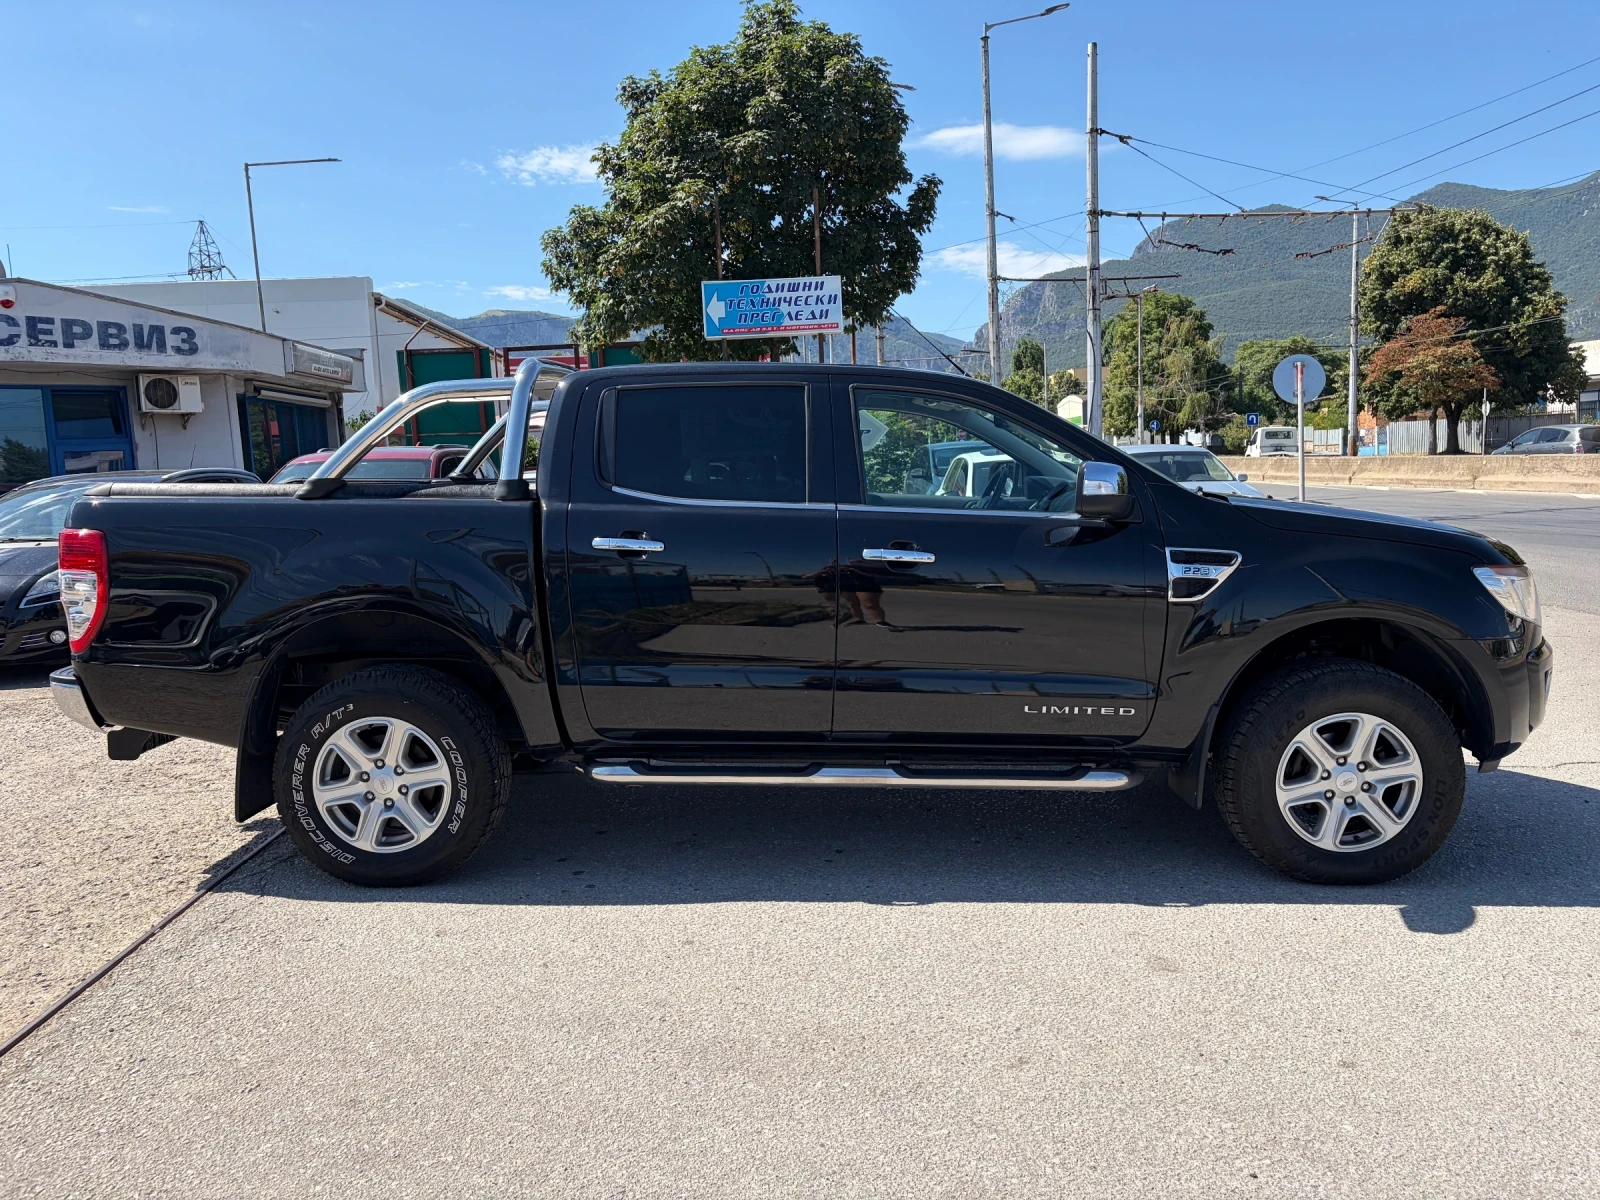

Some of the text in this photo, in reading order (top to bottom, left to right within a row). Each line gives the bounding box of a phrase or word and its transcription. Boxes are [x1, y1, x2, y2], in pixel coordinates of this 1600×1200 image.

[739, 280, 825, 295] ГОДИШНИ
[727, 294, 838, 310] ТЕХНИЧЕСКИ
[737, 308, 830, 324] ПРЕГЛЕДИ
[1024, 705, 1136, 716] LIMITED
[440, 736, 468, 834] COOPER
[291, 743, 356, 865] DISCOVERER
